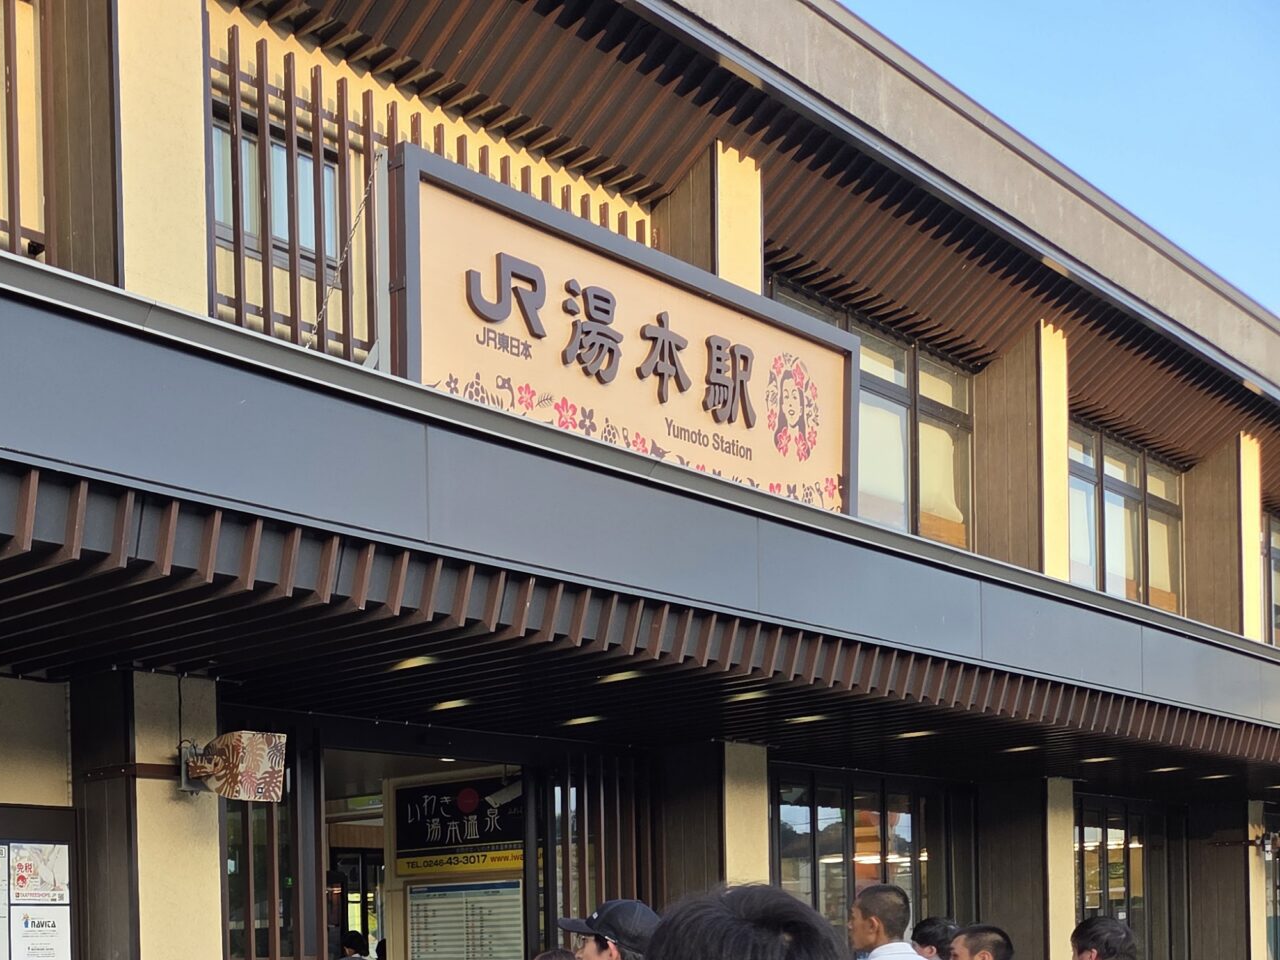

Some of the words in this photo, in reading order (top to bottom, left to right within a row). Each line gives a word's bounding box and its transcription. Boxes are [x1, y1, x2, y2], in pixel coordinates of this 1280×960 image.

[466, 252, 547, 339] JR
[561, 279, 757, 429] 湯本駅
[476, 327, 533, 361] JR東日本
[665, 417, 710, 448] Yumoto
[712, 433, 753, 461] Station
[408, 794, 452, 824] いわき
[426, 808, 503, 844] 湯本温泉
